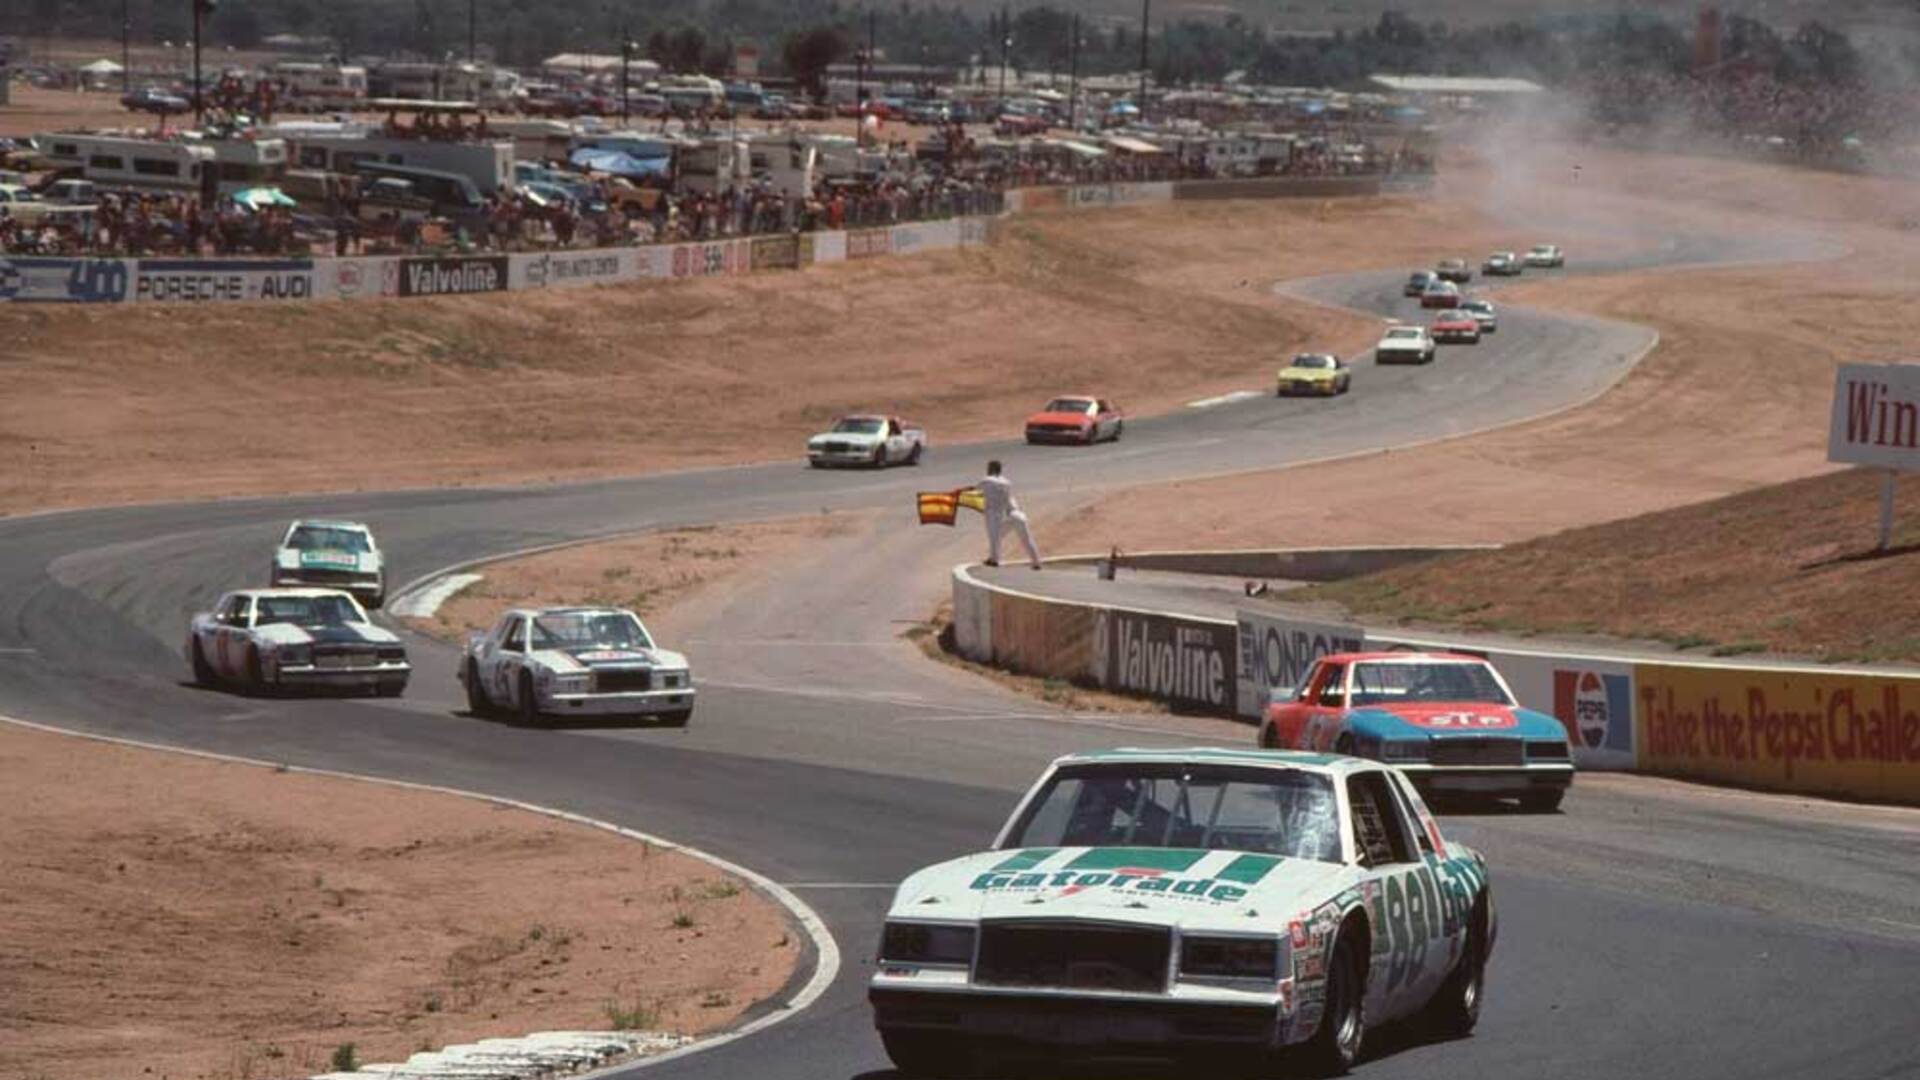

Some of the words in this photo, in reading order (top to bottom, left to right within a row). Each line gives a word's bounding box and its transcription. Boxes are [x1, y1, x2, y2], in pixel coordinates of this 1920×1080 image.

[137, 276, 243, 300] PORSCHE
[260, 276, 312, 299] AUDI
[408, 262, 497, 294] Valvoline
[1846, 381, 1918, 448] Win
[1117, 617, 1226, 706] Valvoline
[1428, 710, 1503, 727] STP
[1640, 684, 1699, 757] Take
[1702, 695, 1746, 762] the
[1747, 685, 1826, 781] Pepsi
[968, 868, 1249, 904] Gatorade
